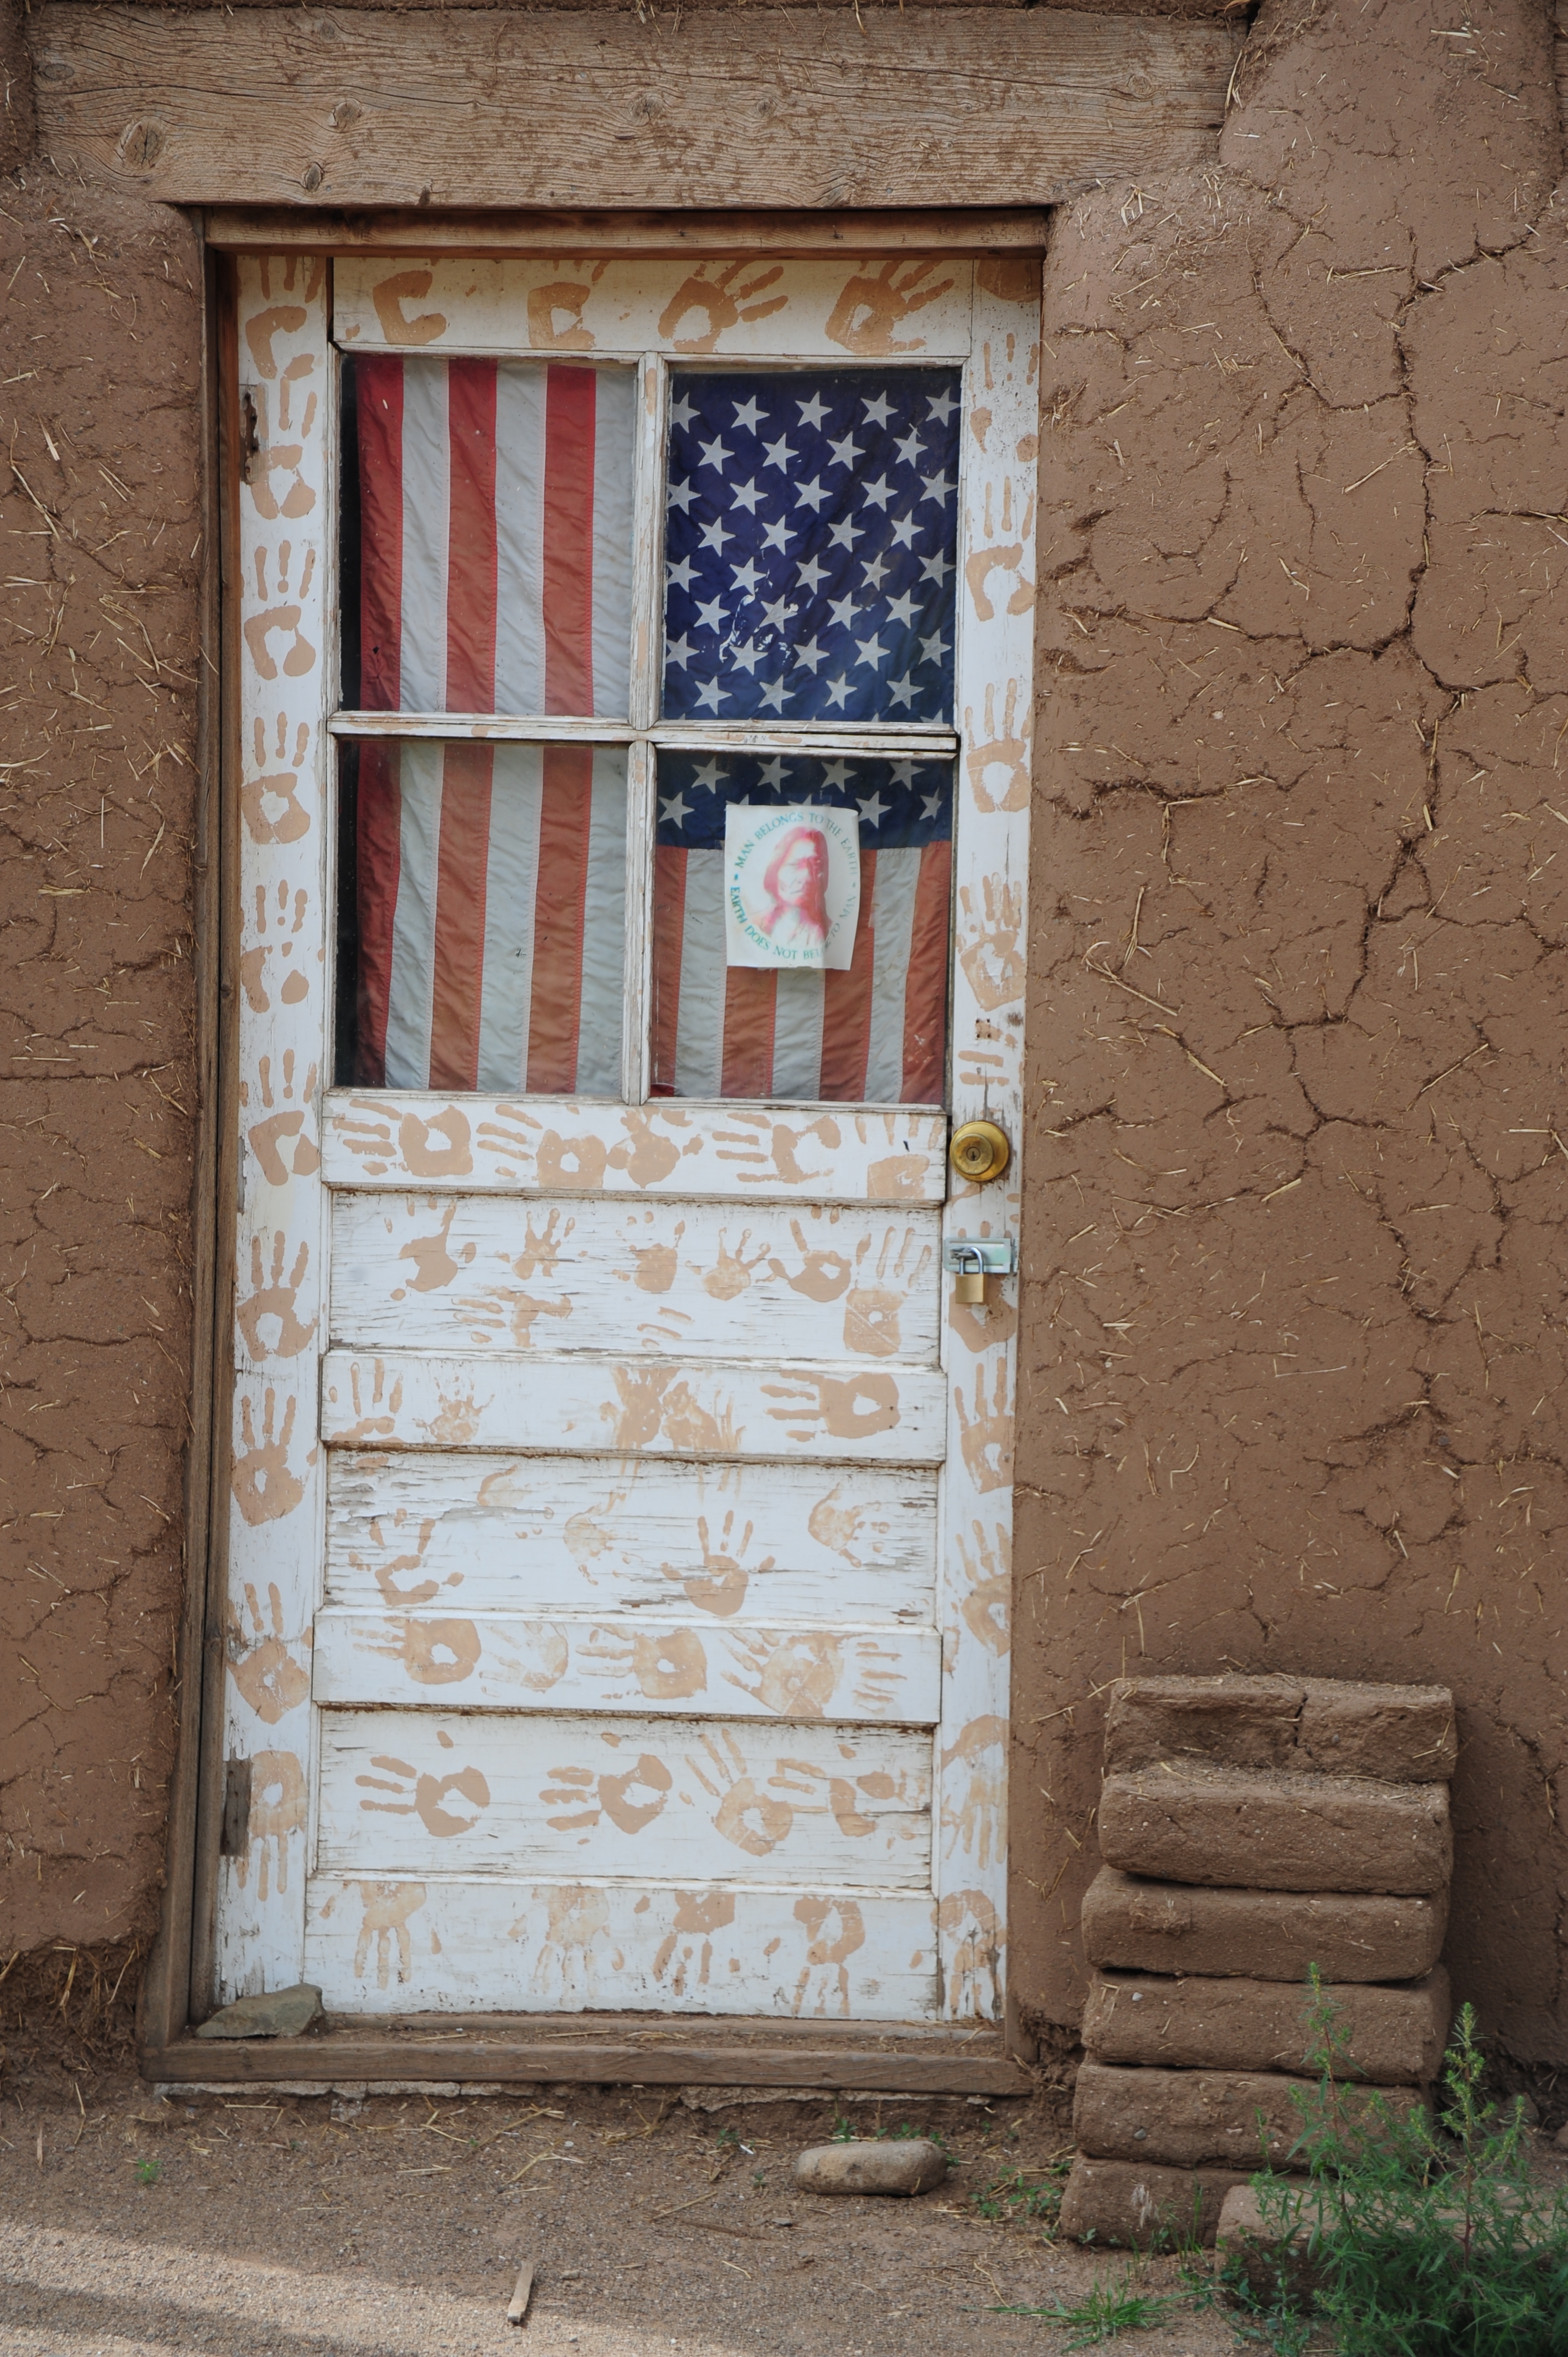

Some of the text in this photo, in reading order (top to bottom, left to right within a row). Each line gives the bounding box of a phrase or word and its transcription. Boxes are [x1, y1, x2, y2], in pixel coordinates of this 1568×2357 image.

[735, 812, 858, 876] MAN BELONGS TO THE EARTH
[730, 887, 747, 924] EARTH
[745, 925, 771, 950] DOES
[773, 946, 798, 960] NOT
[831, 923, 841, 938] TO
[839, 895, 857, 919] MAN
